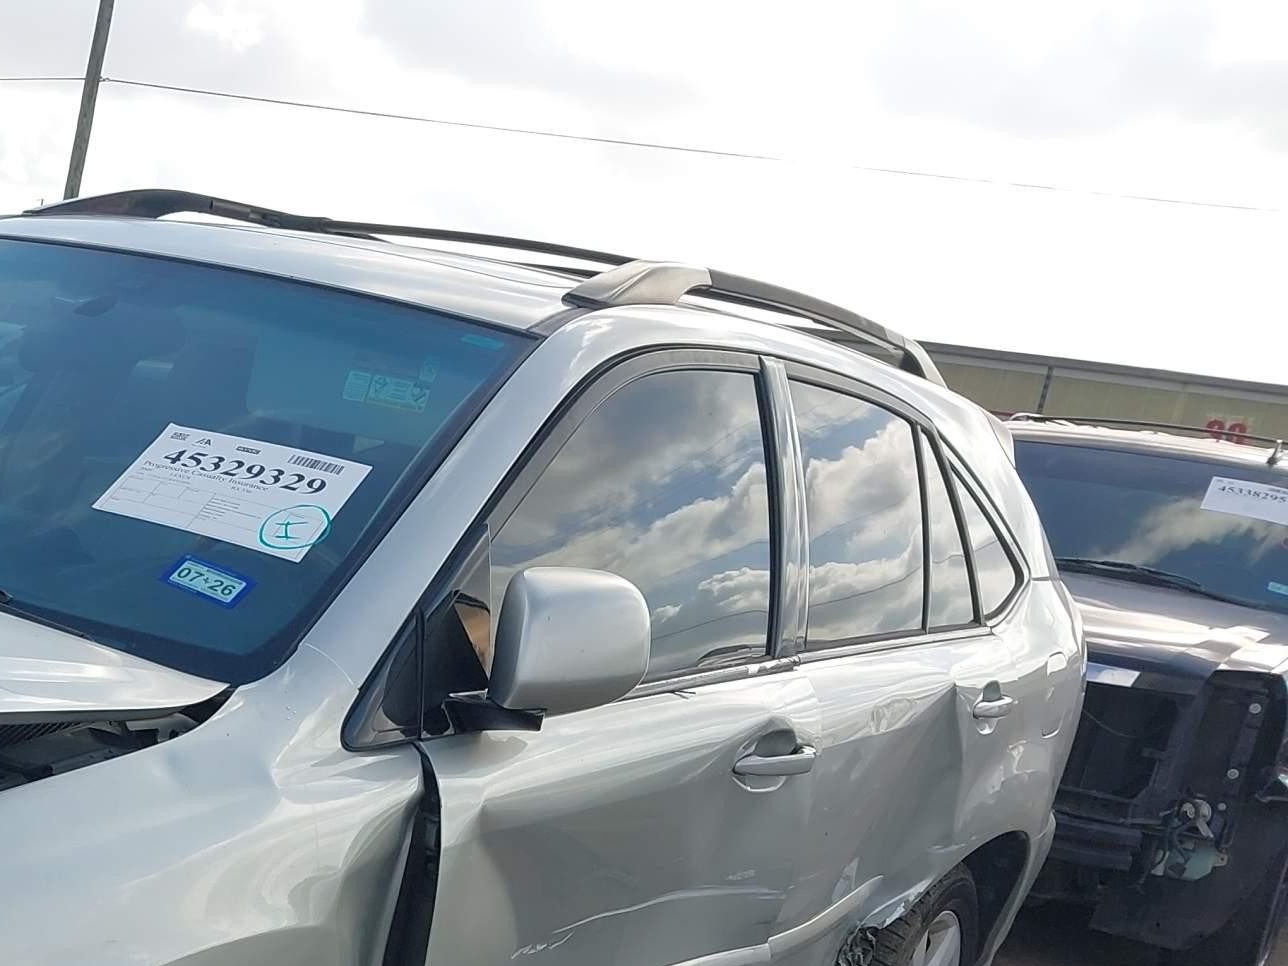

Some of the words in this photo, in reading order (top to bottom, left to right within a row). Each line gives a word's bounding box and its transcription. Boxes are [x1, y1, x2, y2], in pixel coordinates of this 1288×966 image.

[144, 460, 190, 473] Progressive
[192, 470, 224, 483] Casualty
[229, 479, 269, 491] Insurance
[163, 449, 327, 494] 45329329
